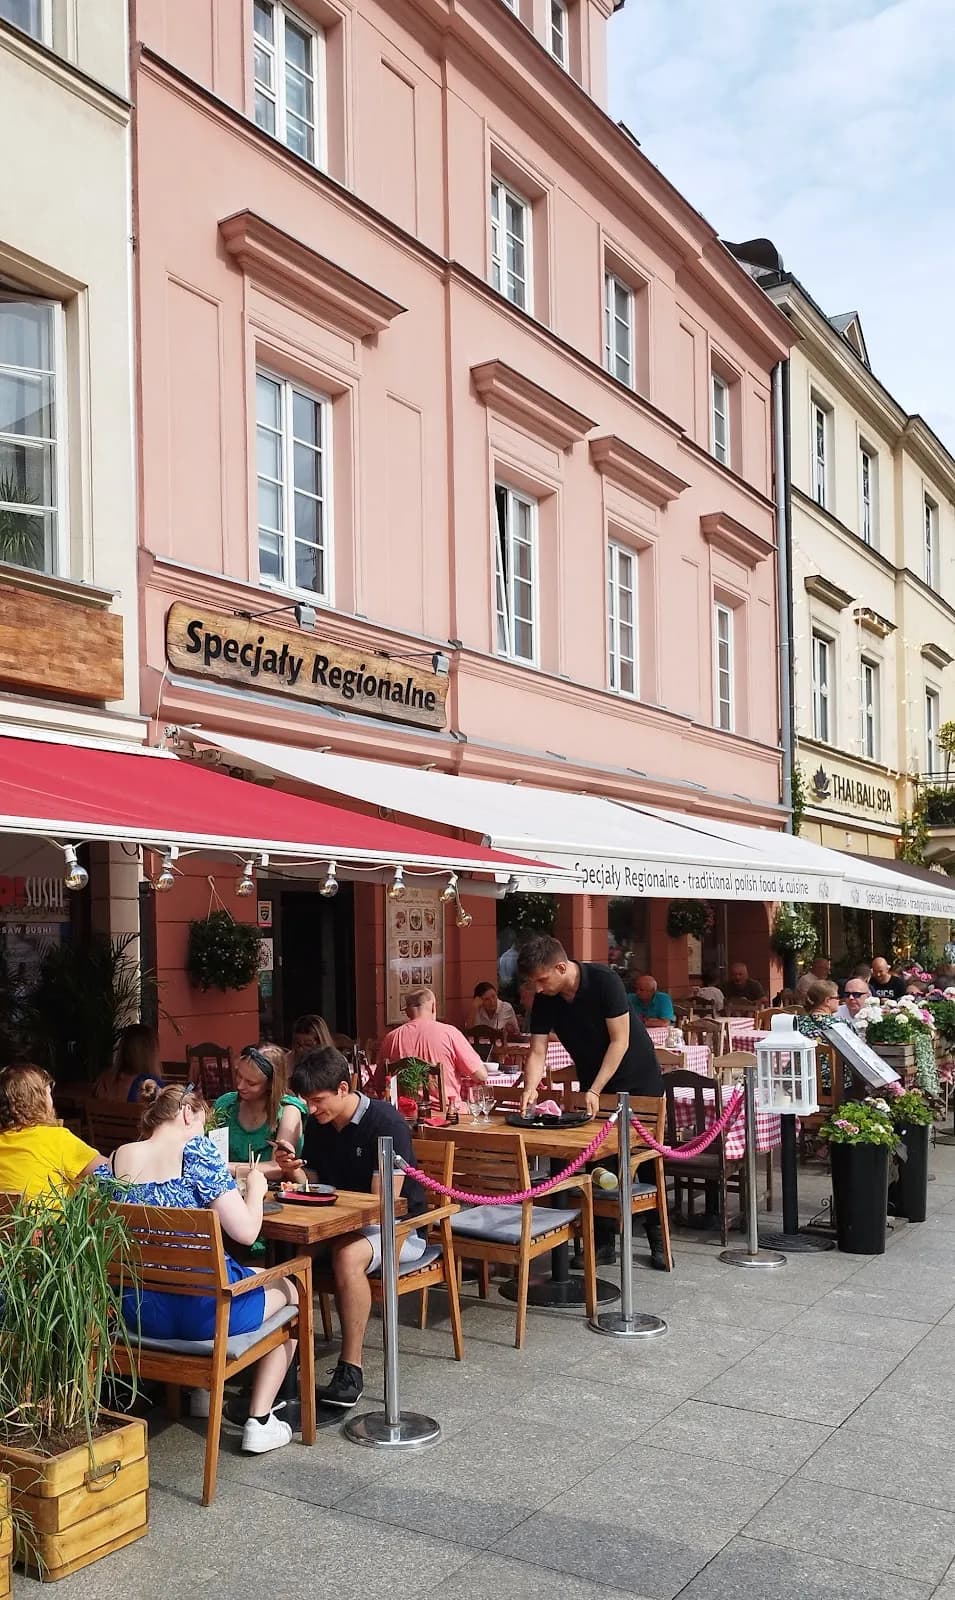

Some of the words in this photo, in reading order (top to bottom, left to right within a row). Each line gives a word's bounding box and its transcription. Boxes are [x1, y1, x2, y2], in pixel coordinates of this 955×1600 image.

[186, 620, 303, 686] Specjały
[311, 654, 436, 711] Regionalne
[832, 774, 855, 804] THAI
[856, 781, 875, 809] BALI
[877, 788, 892, 812] SPA
[25, 876, 64, 908] SUSHI
[624, 866, 679, 893] Regionalne
[688, 871, 733, 890] traditional
[735, 874, 757, 896] polish
[759, 875, 777, 893] food
[779, 878, 785, 893] &
[786, 878, 809, 895] cuisine
[0, 926, 21, 935] SAW
[25, 926, 52, 935] SUSHI
